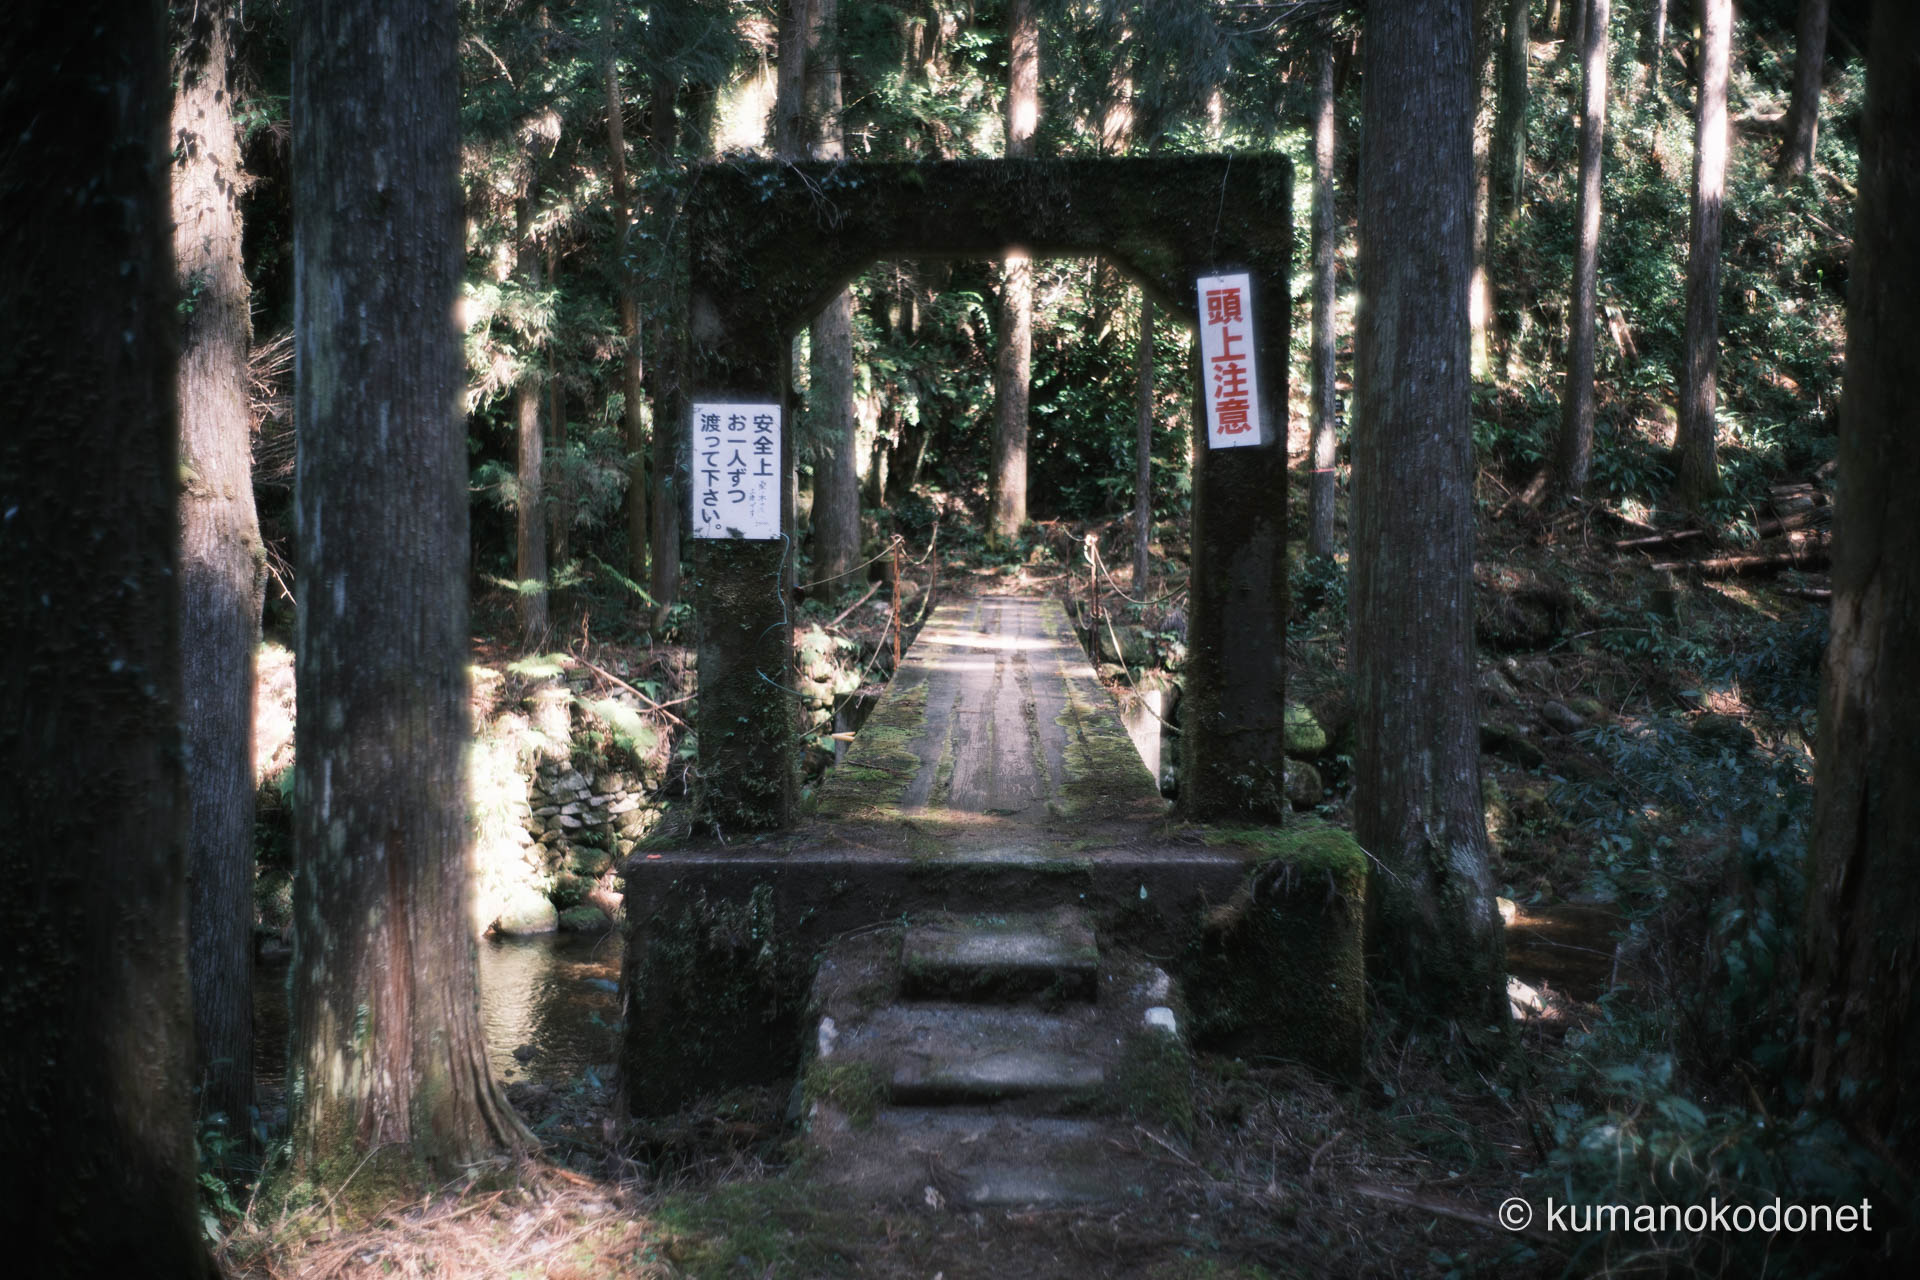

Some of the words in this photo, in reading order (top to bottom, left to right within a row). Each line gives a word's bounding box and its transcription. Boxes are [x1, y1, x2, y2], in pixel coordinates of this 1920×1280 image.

[1206, 287, 1252, 435] 頭上注意
[701, 413, 721, 530] 渡って下さい。
[727, 413, 747, 504] お一人ずつ
[753, 413, 774, 476] 安全上
